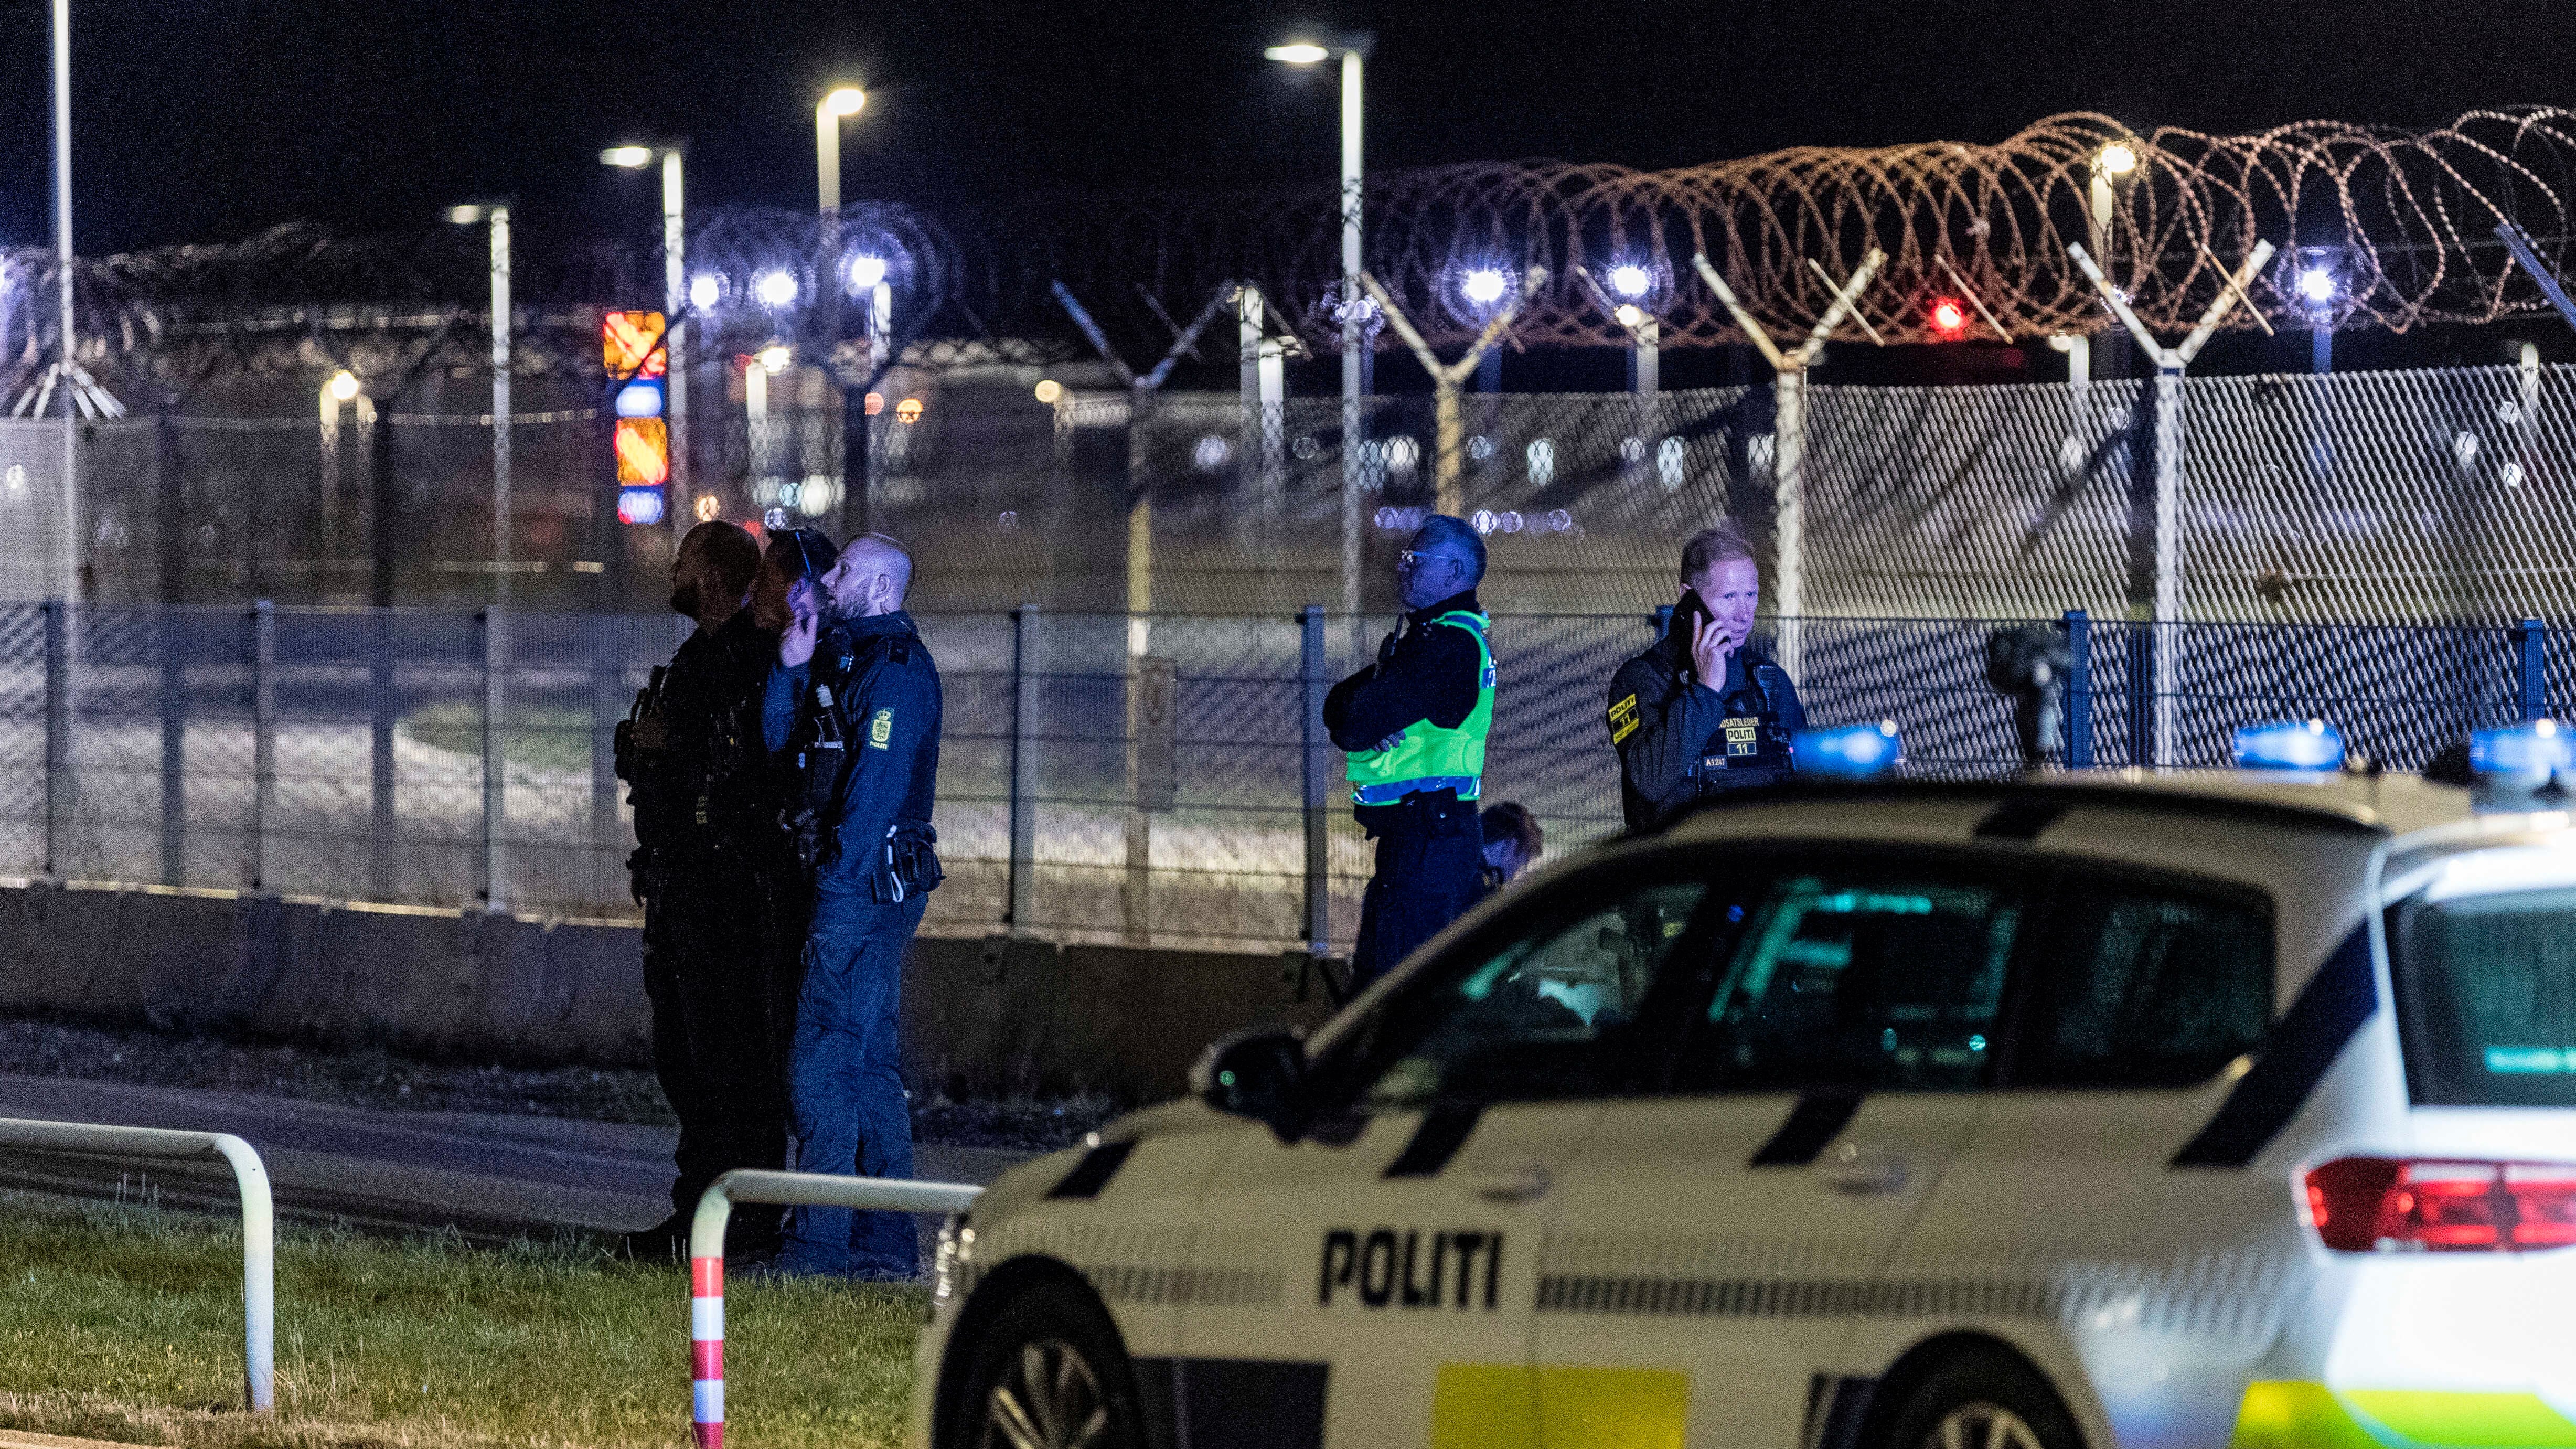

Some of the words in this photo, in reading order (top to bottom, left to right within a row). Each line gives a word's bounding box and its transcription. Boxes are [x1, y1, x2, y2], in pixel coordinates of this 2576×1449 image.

[1611, 697, 1634, 717] POLITI
[1620, 713, 1630, 726] 11
[1728, 729, 1754, 740] POLITI
[1736, 743, 1748, 754] 11
[1319, 1229, 1502, 1309] POLITI
